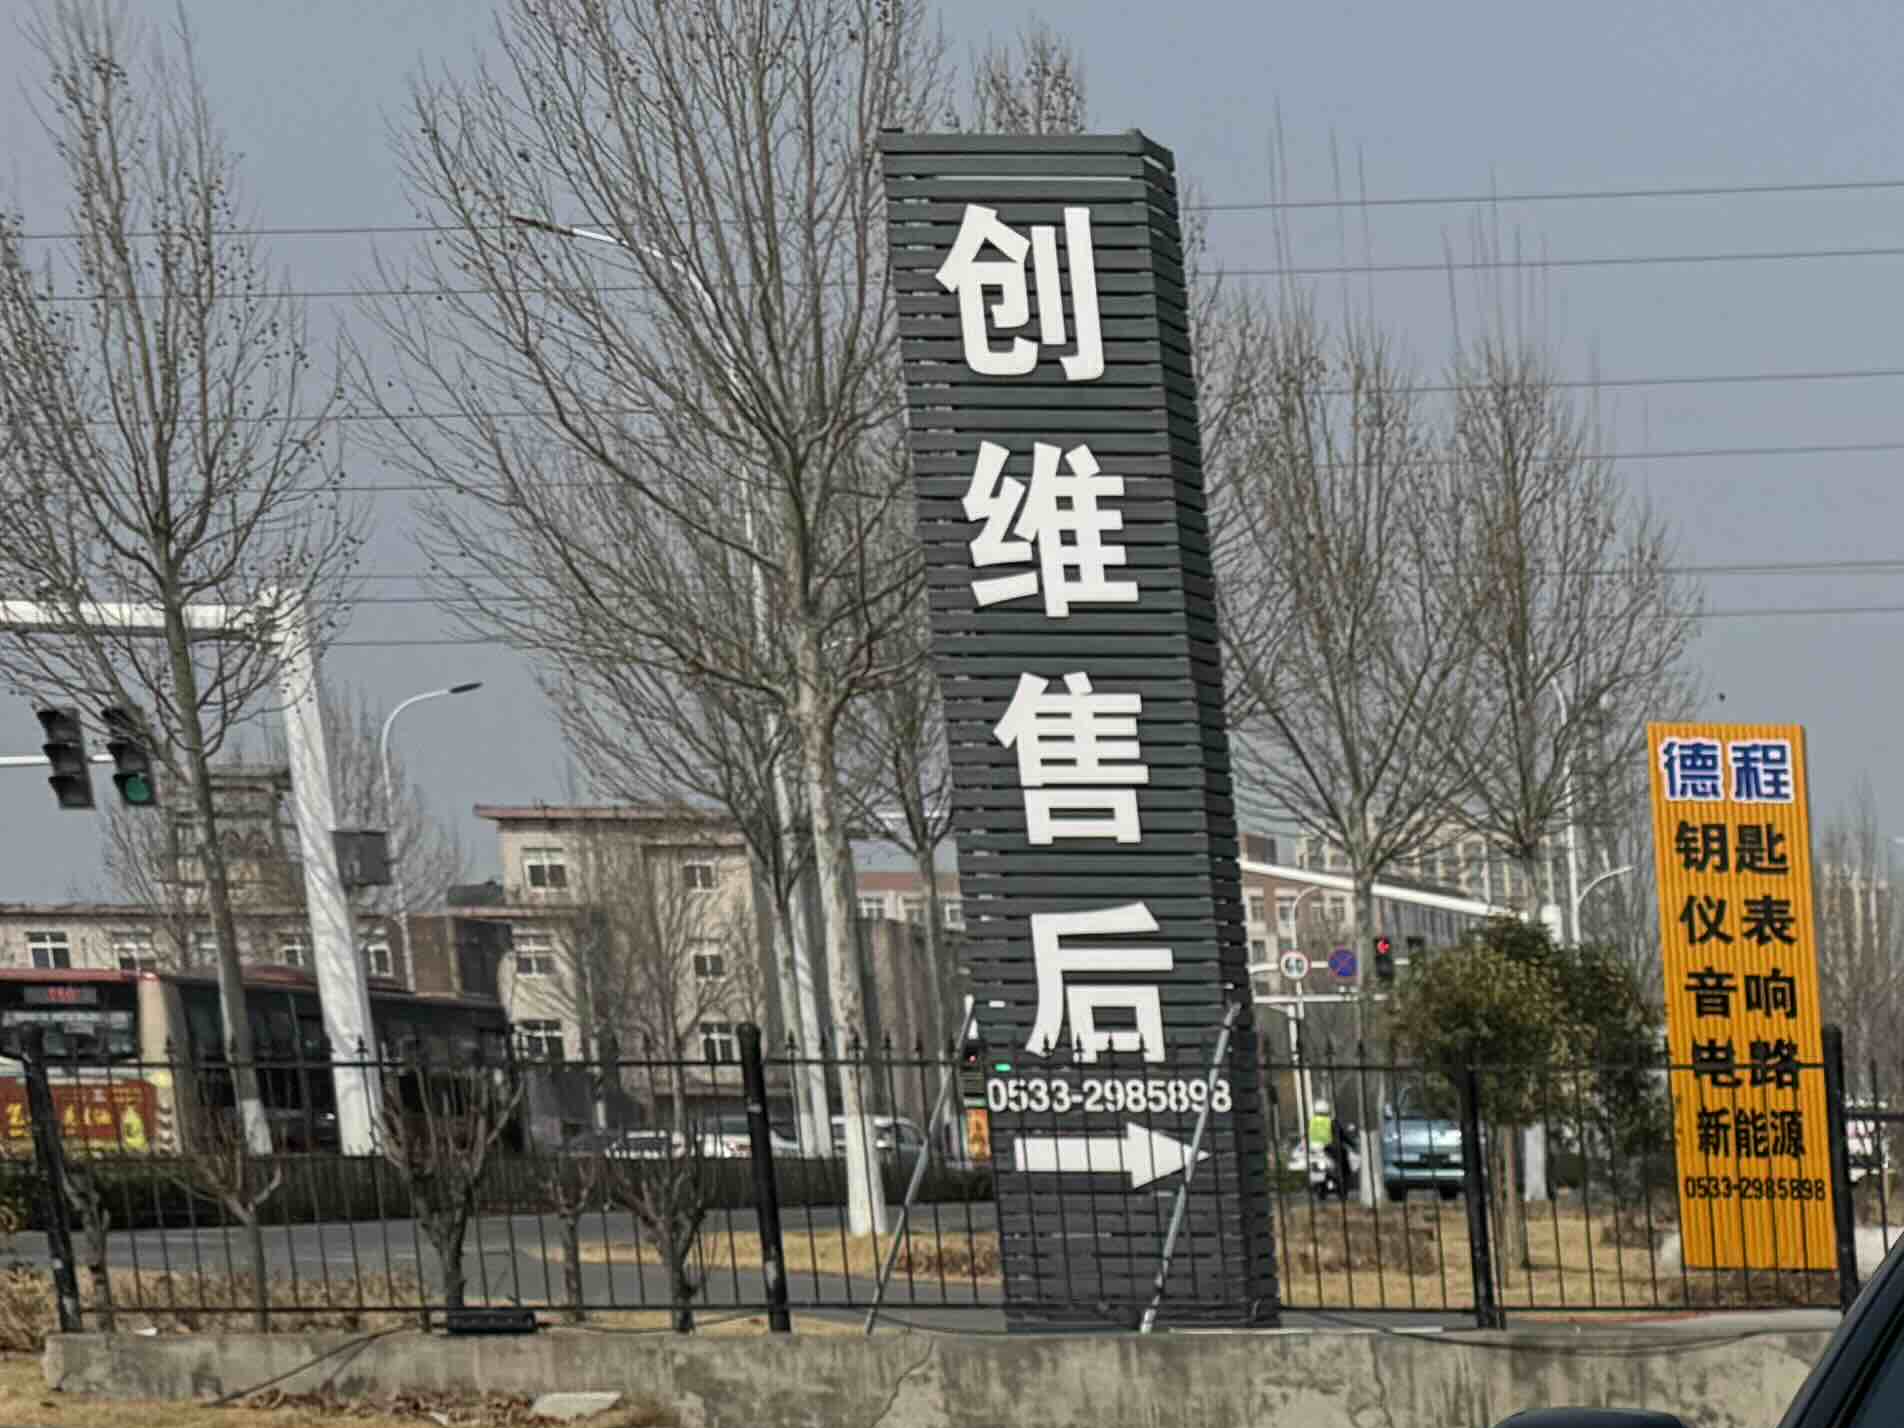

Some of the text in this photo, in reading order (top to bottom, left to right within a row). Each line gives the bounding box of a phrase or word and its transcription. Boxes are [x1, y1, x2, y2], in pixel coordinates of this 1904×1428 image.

[935, 204, 1176, 1064] 创维售后
[1660, 739, 1796, 803] 德程
[1674, 819, 1789, 876] 钥匙
[1679, 893, 1797, 947] 仪表
[1684, 966, 1798, 1020] 音响
[1690, 1036, 1801, 1091] 电路
[986, 1078, 1233, 1113] 0533-2985898
[1696, 1108, 1807, 1160] 新能源
[1685, 1174, 1827, 1202] 0533-2985898
